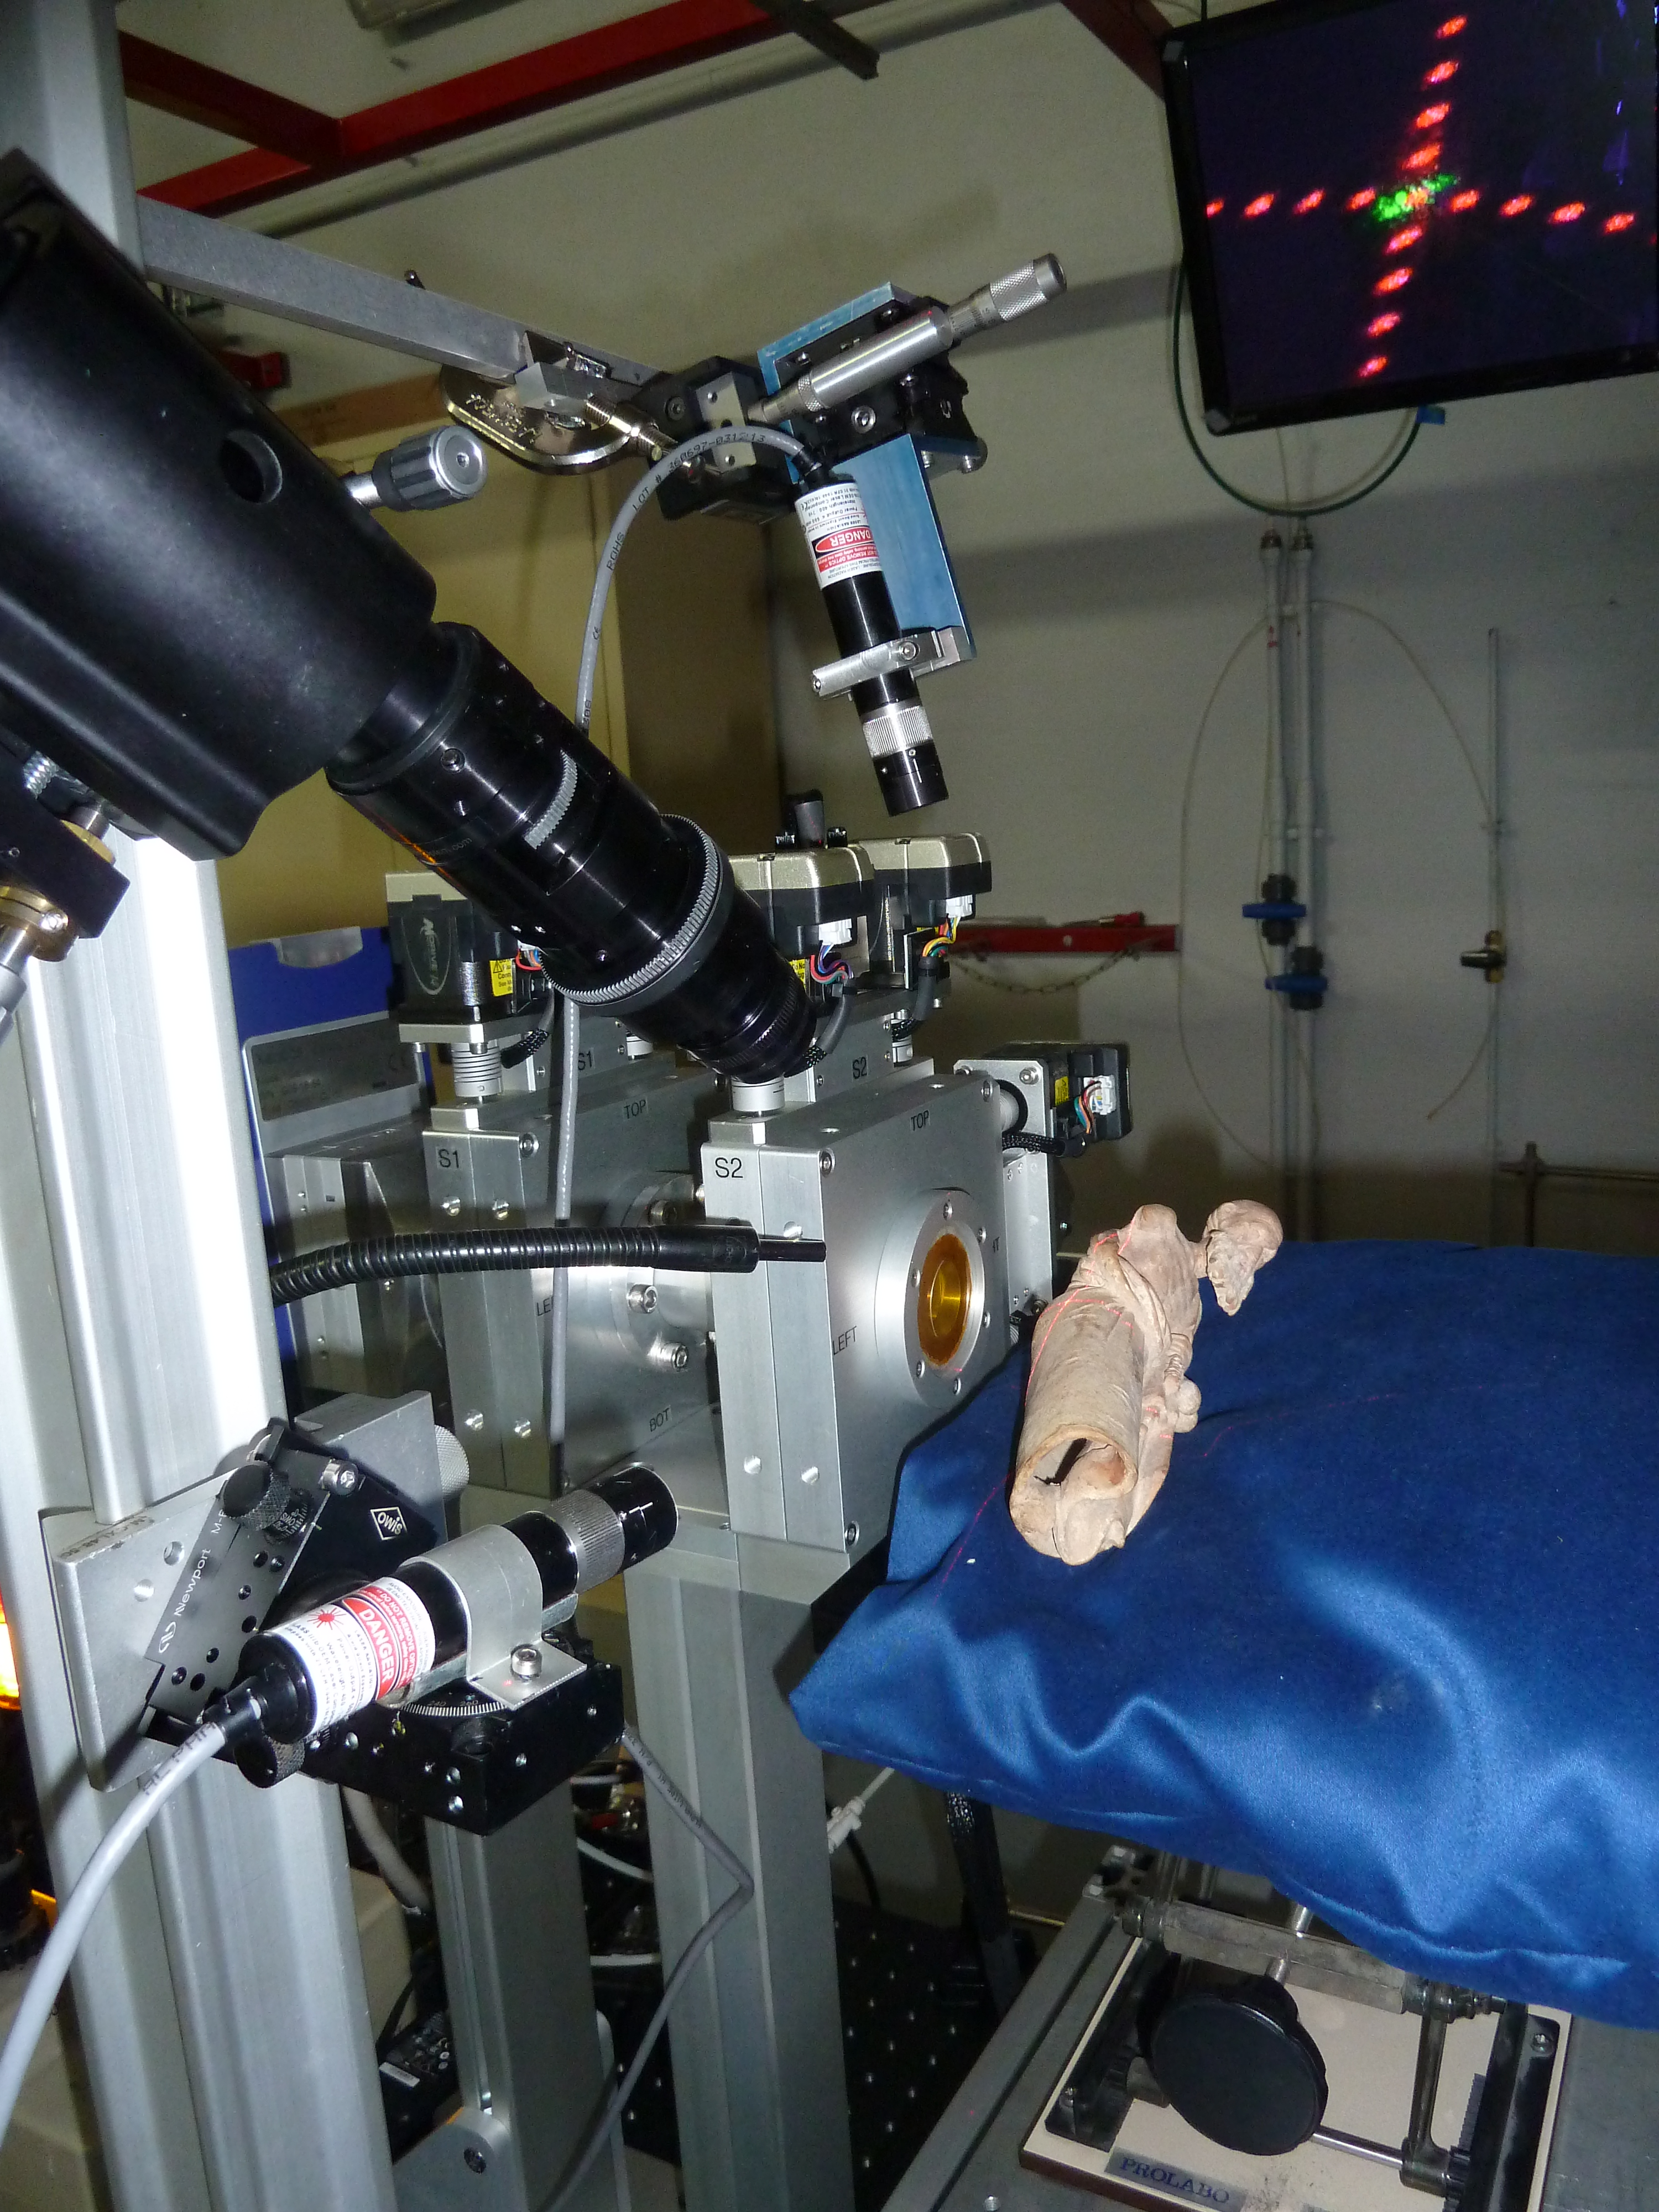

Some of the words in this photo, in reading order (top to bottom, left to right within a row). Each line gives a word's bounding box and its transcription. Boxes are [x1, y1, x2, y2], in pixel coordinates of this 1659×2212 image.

[632, 486, 650, 512] LOT
[830, 530, 872, 547] DANGER
[852, 1058, 868, 1079] S2
[623, 1099, 647, 1120] TOP
[910, 1110, 930, 1132] TOP
[438, 1148, 460, 1168] S1
[714, 1157, 744, 1179] S2
[832, 1324, 857, 1356] LEFT
[649, 1408, 670, 1432] BOT
[174, 1548, 211, 1616] Newport
[388, 1601, 404, 1616] NOT
[399, 1616, 415, 1651] REMOVE
[359, 1608, 395, 1683] DANGER
[1119, 2157, 1230, 2204] PROLABO
